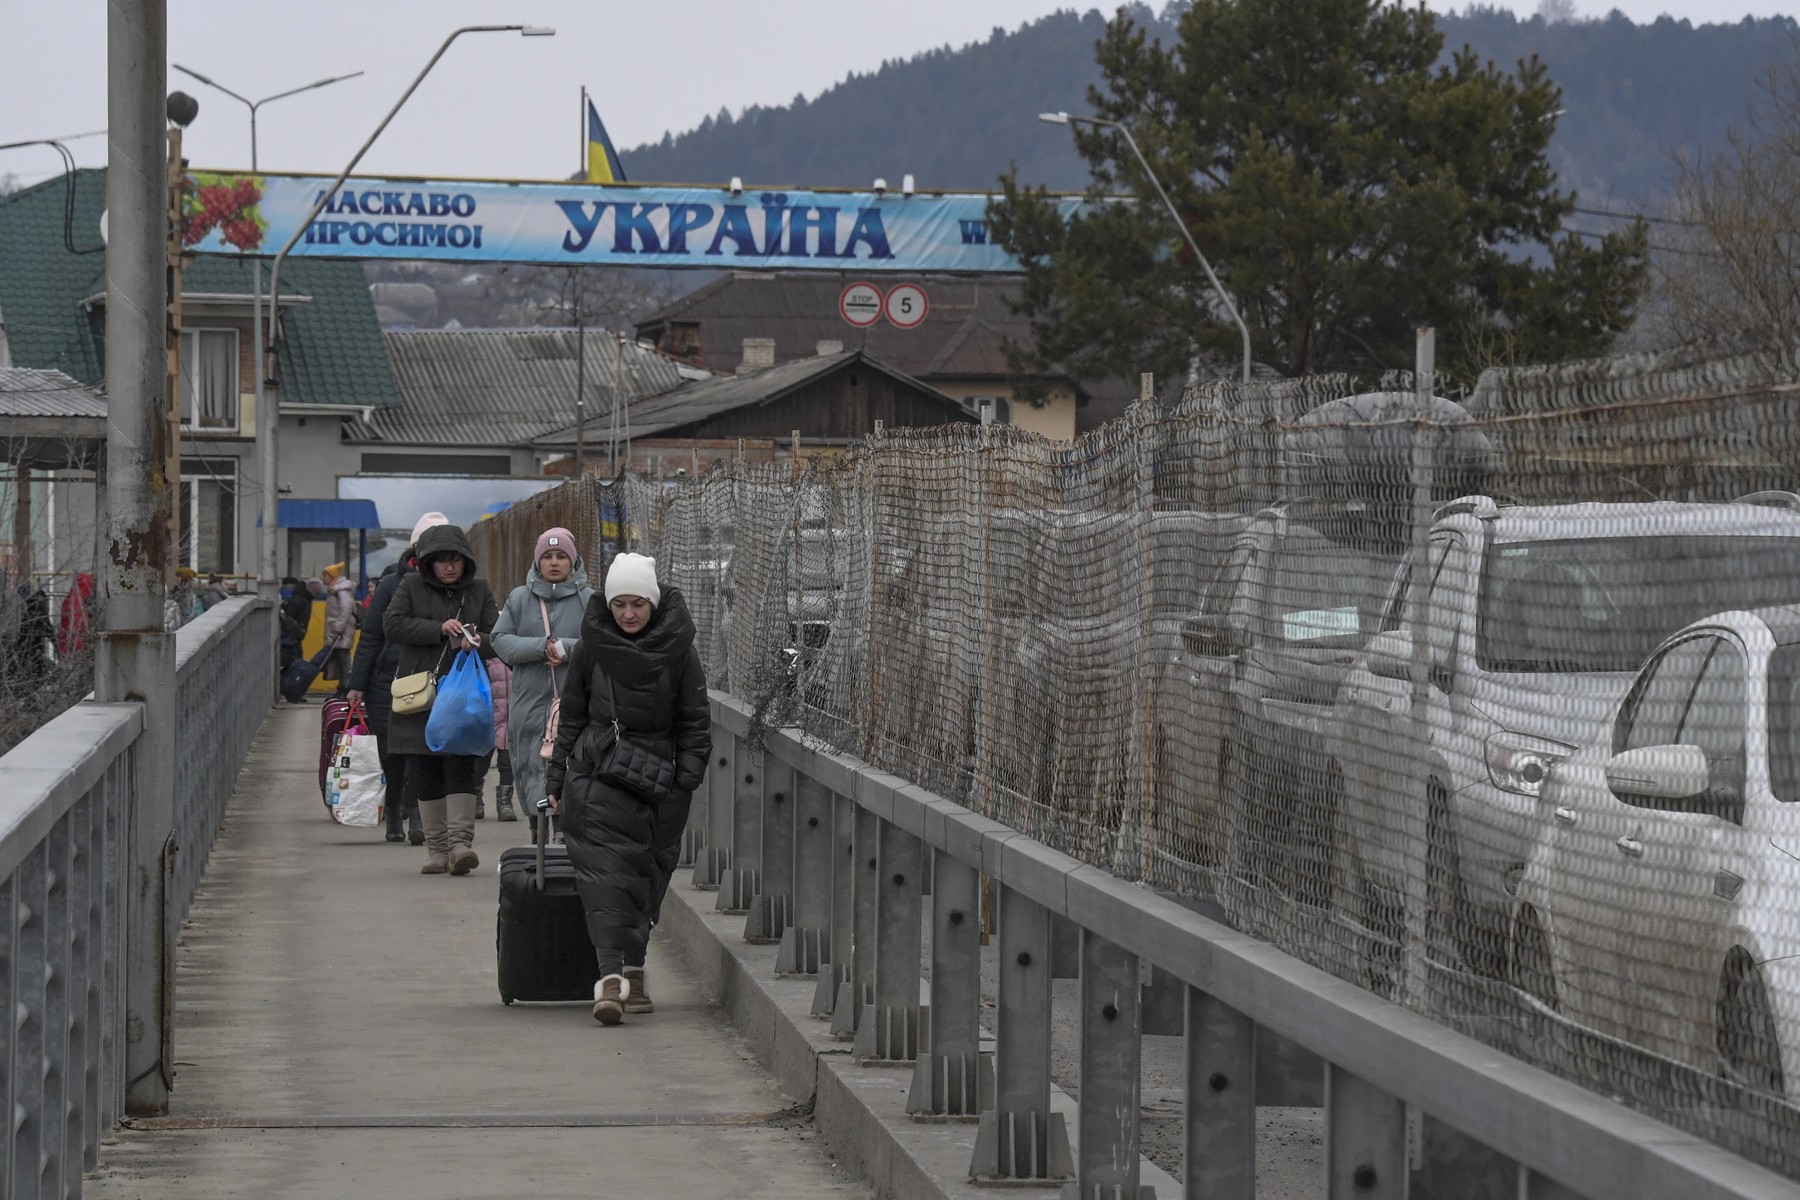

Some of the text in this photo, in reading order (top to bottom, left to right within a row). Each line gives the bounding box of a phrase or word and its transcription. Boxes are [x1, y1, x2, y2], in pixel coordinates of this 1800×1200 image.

[305, 221, 483, 249] ПРОСИМО!
[555, 193, 896, 259] УКРАЇНА
[852, 295, 873, 303] STOP
[901, 297, 912, 314] 5
